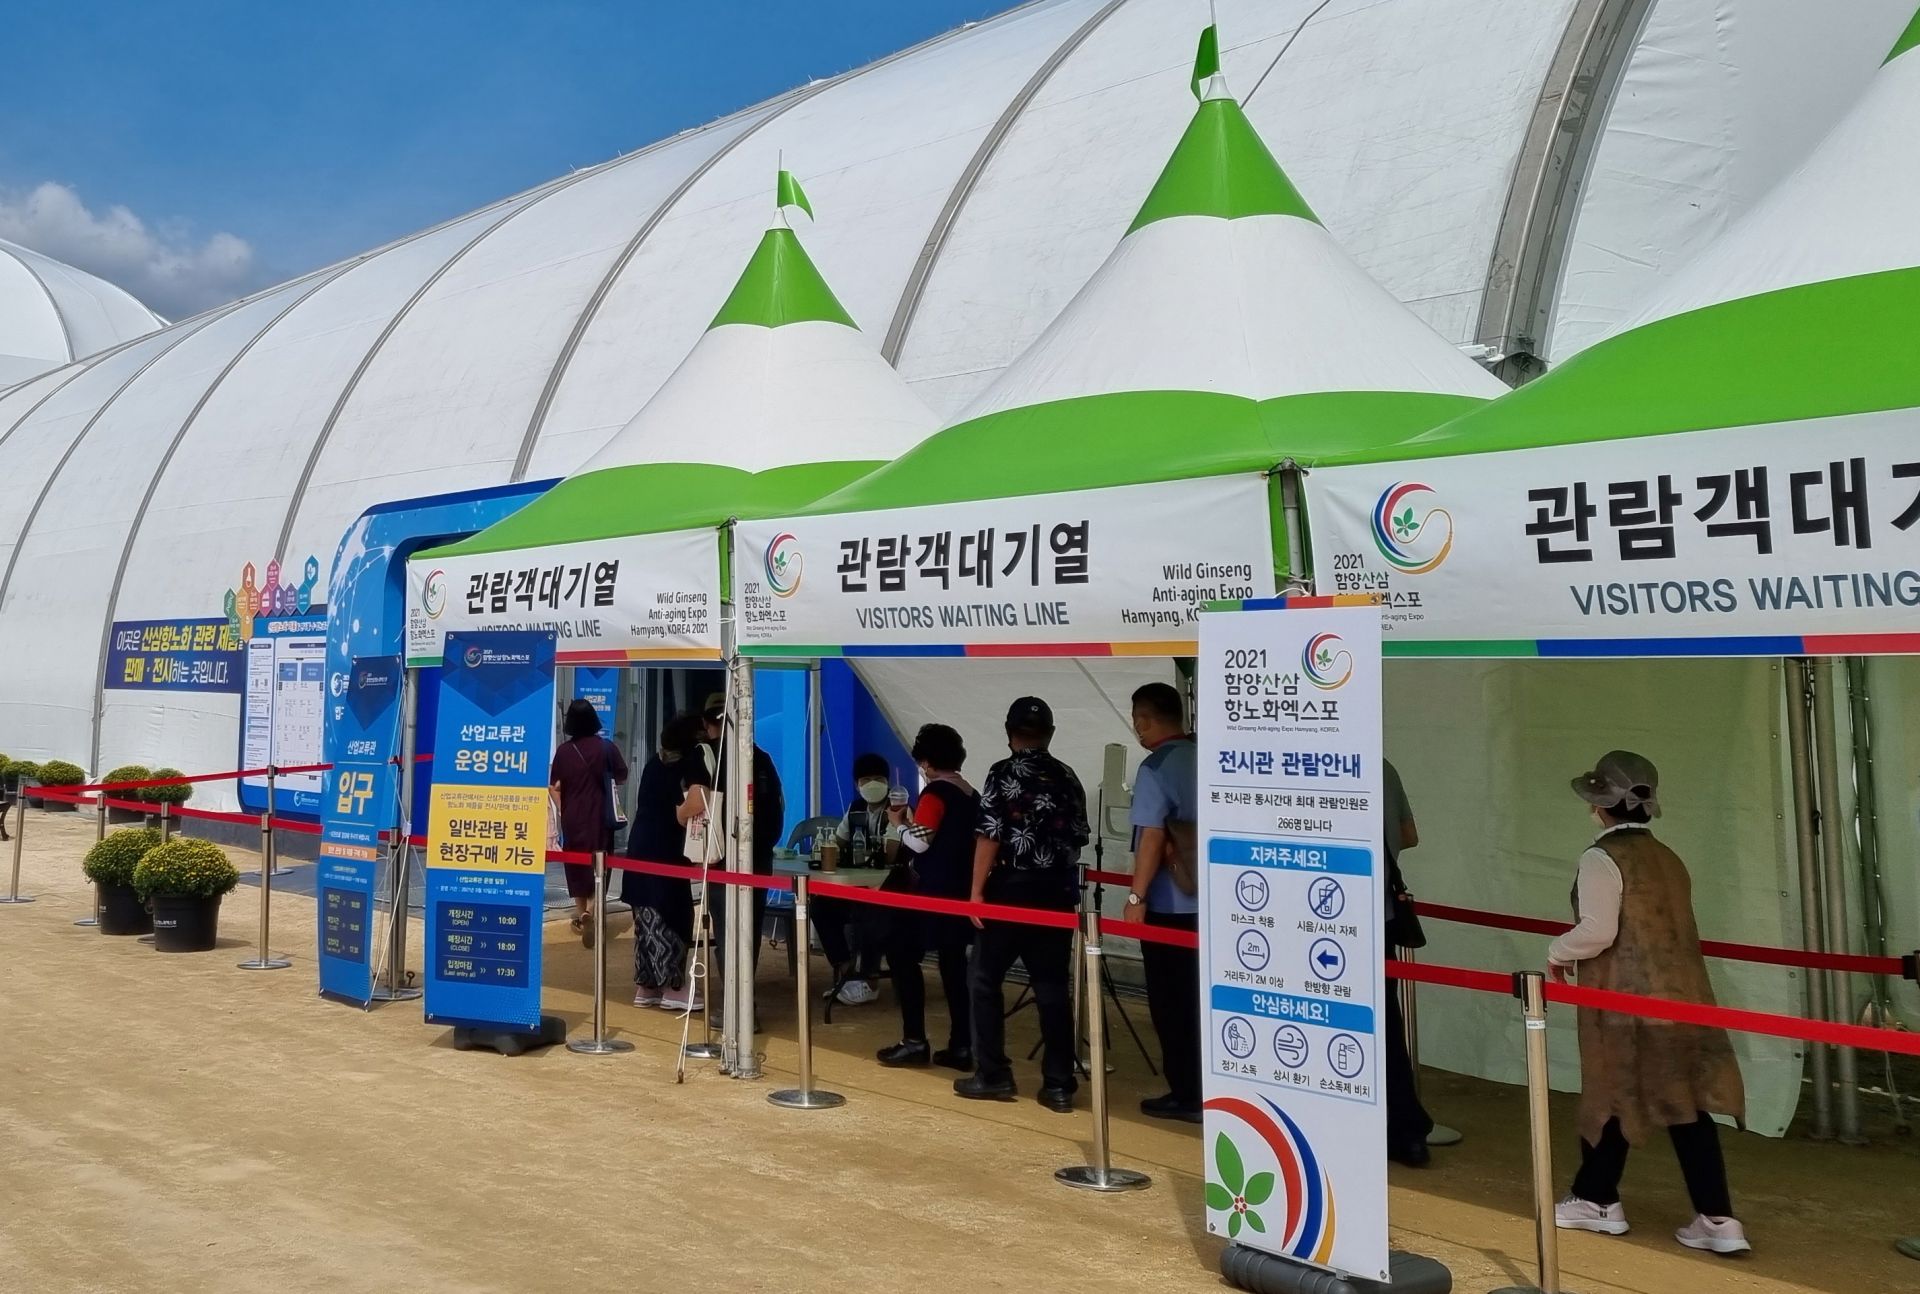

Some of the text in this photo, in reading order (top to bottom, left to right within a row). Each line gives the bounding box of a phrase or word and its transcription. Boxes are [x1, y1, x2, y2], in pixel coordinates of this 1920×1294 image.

[837, 519, 1090, 593] 관람객대기열
[1334, 553, 1364, 569] 2021
[1163, 562, 1252, 581] Wild Ginseng
[1335, 571, 1389, 590] 함양산삼
[466, 559, 620, 615] 관람객대기열
[744, 582, 760, 594] 2021
[1152, 583, 1253, 605] Anti-aging Expo
[1570, 570, 1920, 616] VISITORS WAITING
[656, 592, 707, 605] Wild Ginseng
[648, 606, 708, 622] Anti-aging Expo
[856, 601, 1070, 630] VISITORS WAITING LINE
[1121, 608, 1184, 627] Hamyang,
[575, 619, 602, 638] LINE
[630, 622, 709, 639] Hamyang, KOREA 2021
[116, 629, 141, 651] 이곳은
[141, 625, 192, 652] 산삼항노화
[193, 625, 217, 652] 관련
[1224, 648, 1267, 669] 2021
[124, 657, 229, 684] 판매 전시하는 곳입니다.
[1224, 672, 1300, 696] 함양산삼
[1224, 699, 1339, 722] 항노화엑스포
[460, 724, 526, 743] 산업교류관
[455, 749, 528, 774] 운영 안내
[1218, 750, 1361, 779] 전시관 관람안내
[336, 771, 373, 816] 입구
[1210, 791, 1369, 811] 본 전시관 동시간대 최대 관람인원은
[449, 819, 528, 841] 일반관람 및
[440, 842, 535, 866] 현장구매 가능
[1250, 845, 1328, 870] 지켜주세요!
[448, 909, 474, 919] 개장시간
[498, 916, 517, 925] 10:00
[1231, 913, 1275, 928] 마스크 착용
[1297, 920, 1357, 938] 시음/시식 자제
[497, 942, 516, 951] 18:00
[1247, 942, 1260, 953] 2m
[497, 968, 515, 977] 17:30
[1223, 970, 1284, 988] 거리두기 2M 이상
[1304, 980, 1352, 998] 한방향 관람
[1251, 994, 1329, 1023] 안심하세요!
[1221, 1059, 1258, 1076] 정기 소독
[1273, 1069, 1310, 1086] 상시 환기
[1319, 1077, 1370, 1098] 손소독제 비치
